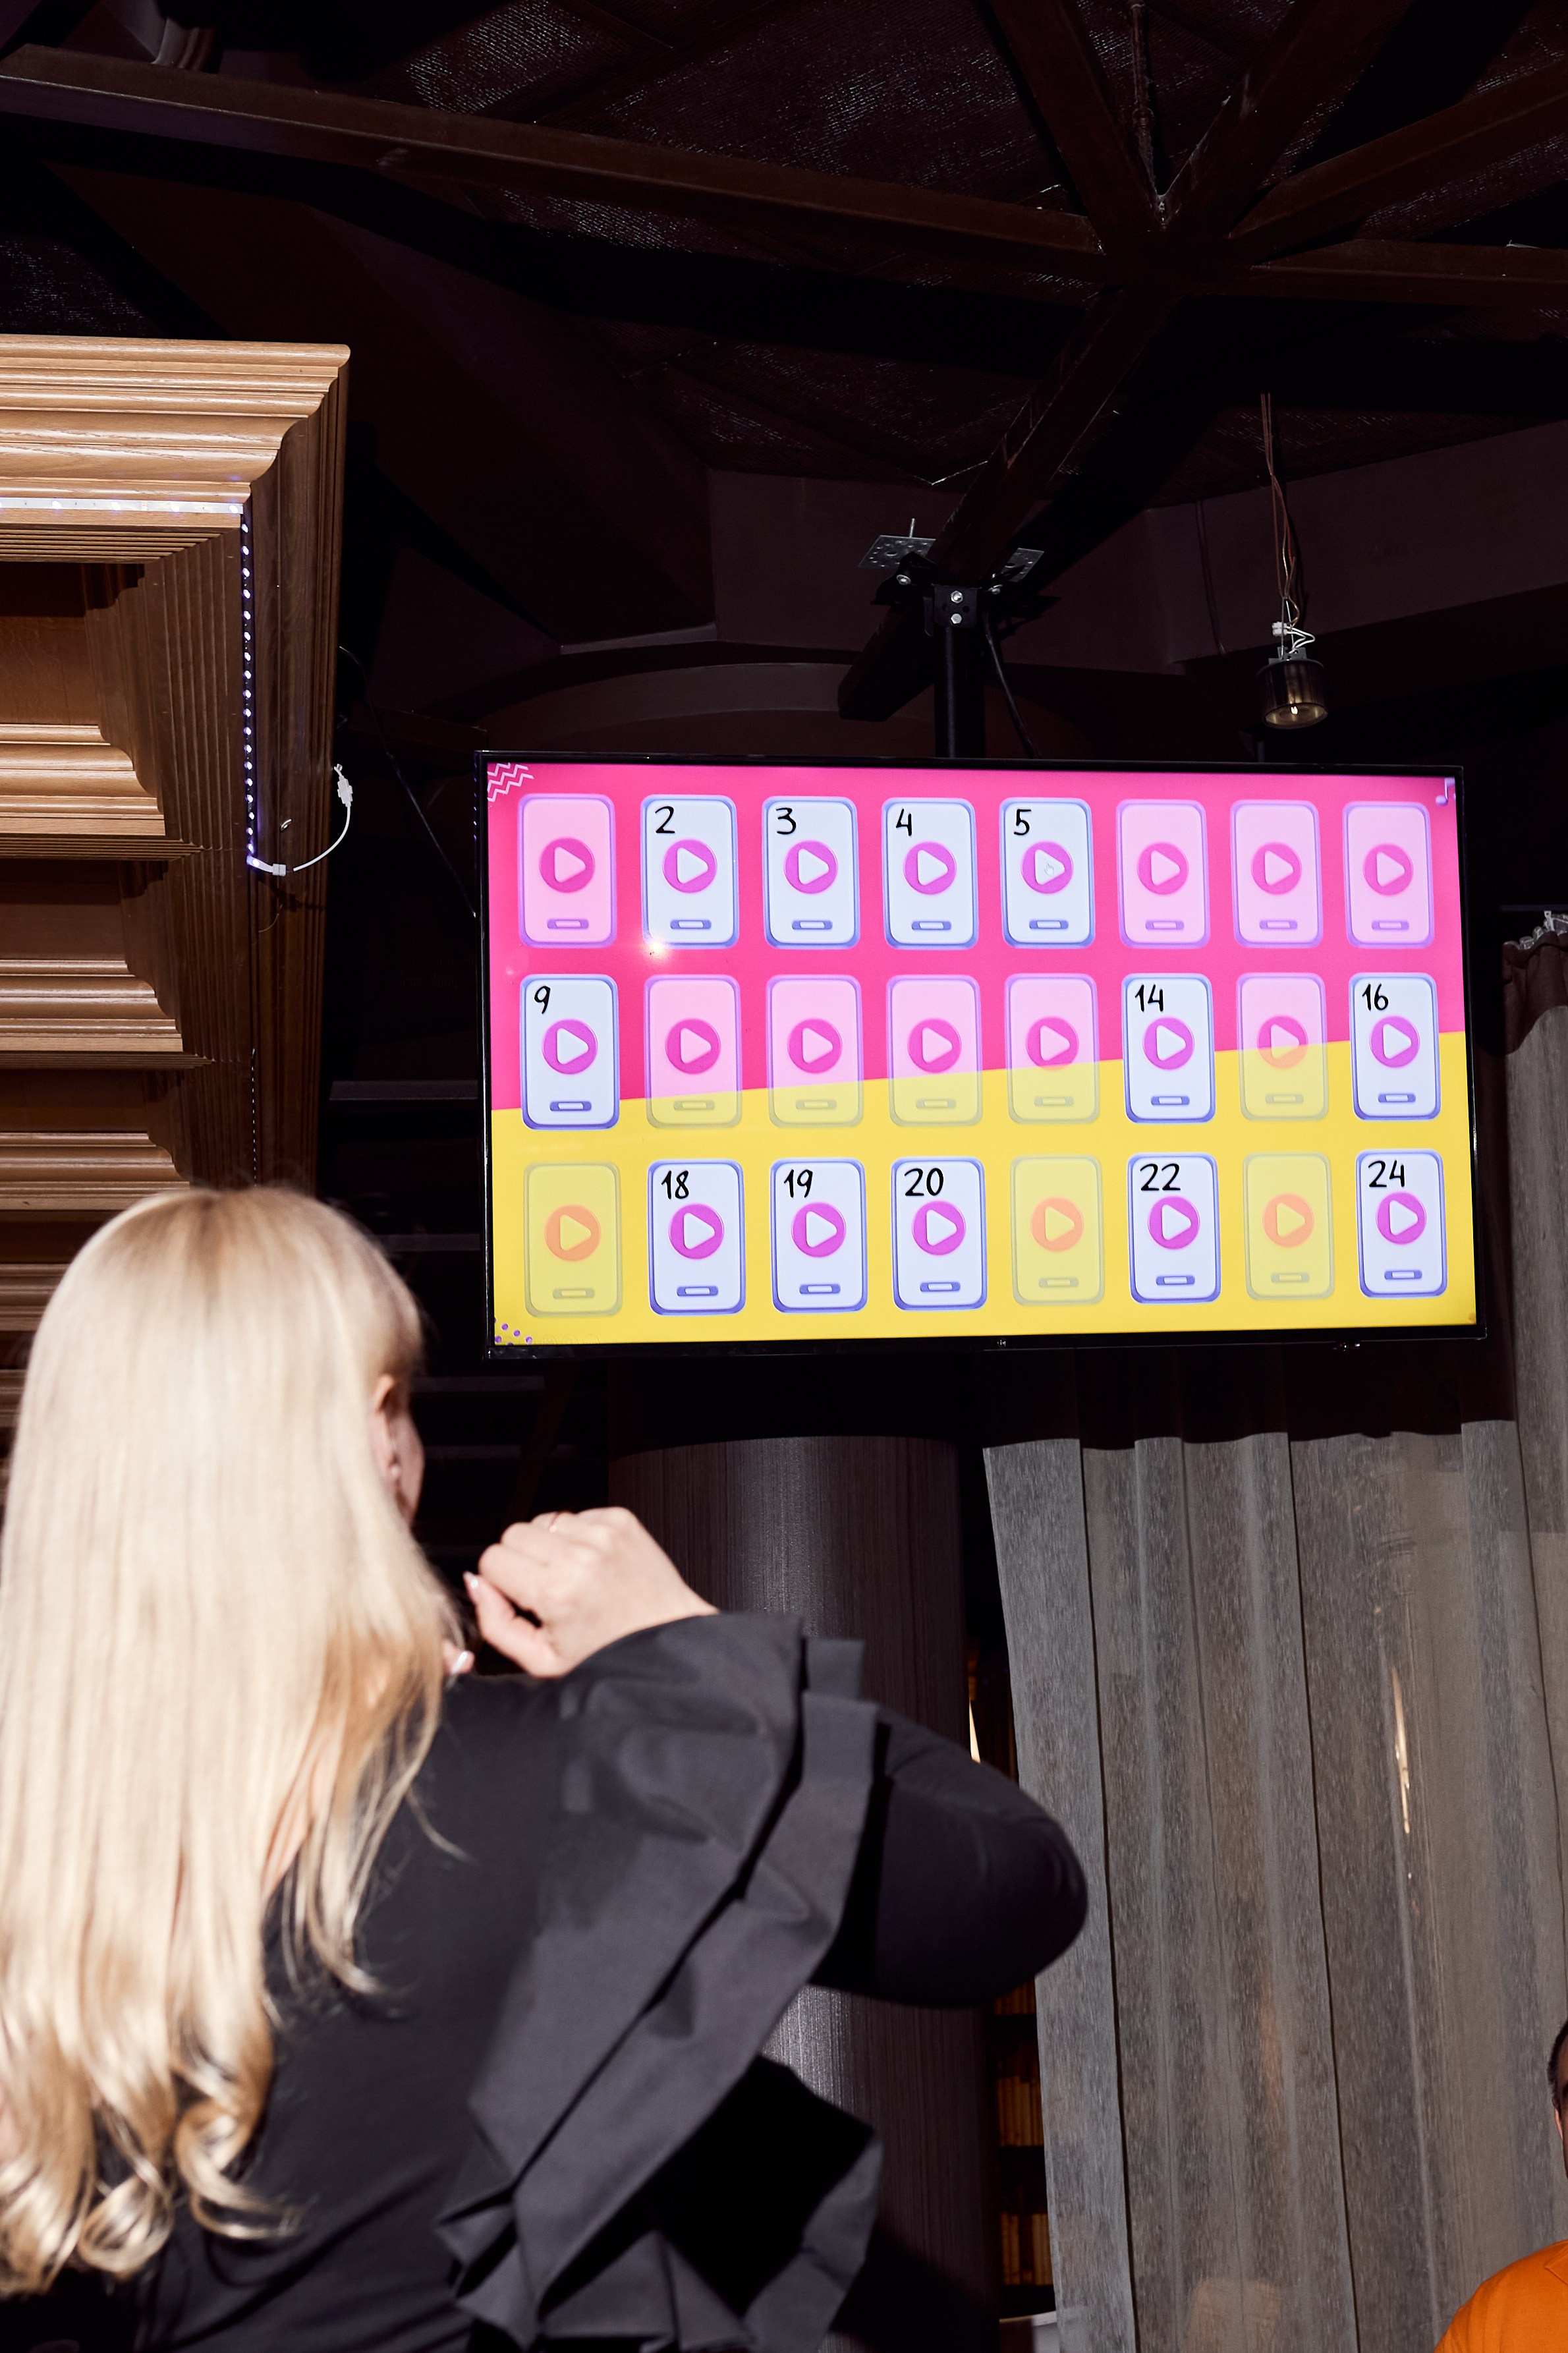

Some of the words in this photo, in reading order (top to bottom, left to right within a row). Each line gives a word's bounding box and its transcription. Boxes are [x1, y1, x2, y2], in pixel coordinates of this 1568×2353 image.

[655, 806, 675, 834] 2
[776, 807, 797, 835] 3
[895, 808, 912, 836] 4
[1013, 808, 1032, 836] 5
[534, 985, 551, 1014] 9
[1134, 984, 1163, 1012] 14
[1362, 984, 1389, 1011] 16
[661, 1170, 689, 1200] 18
[783, 1169, 813, 1198] 19
[904, 1168, 944, 1197] 20
[1140, 1163, 1181, 1191] 22
[1368, 1160, 1405, 1187] 24
